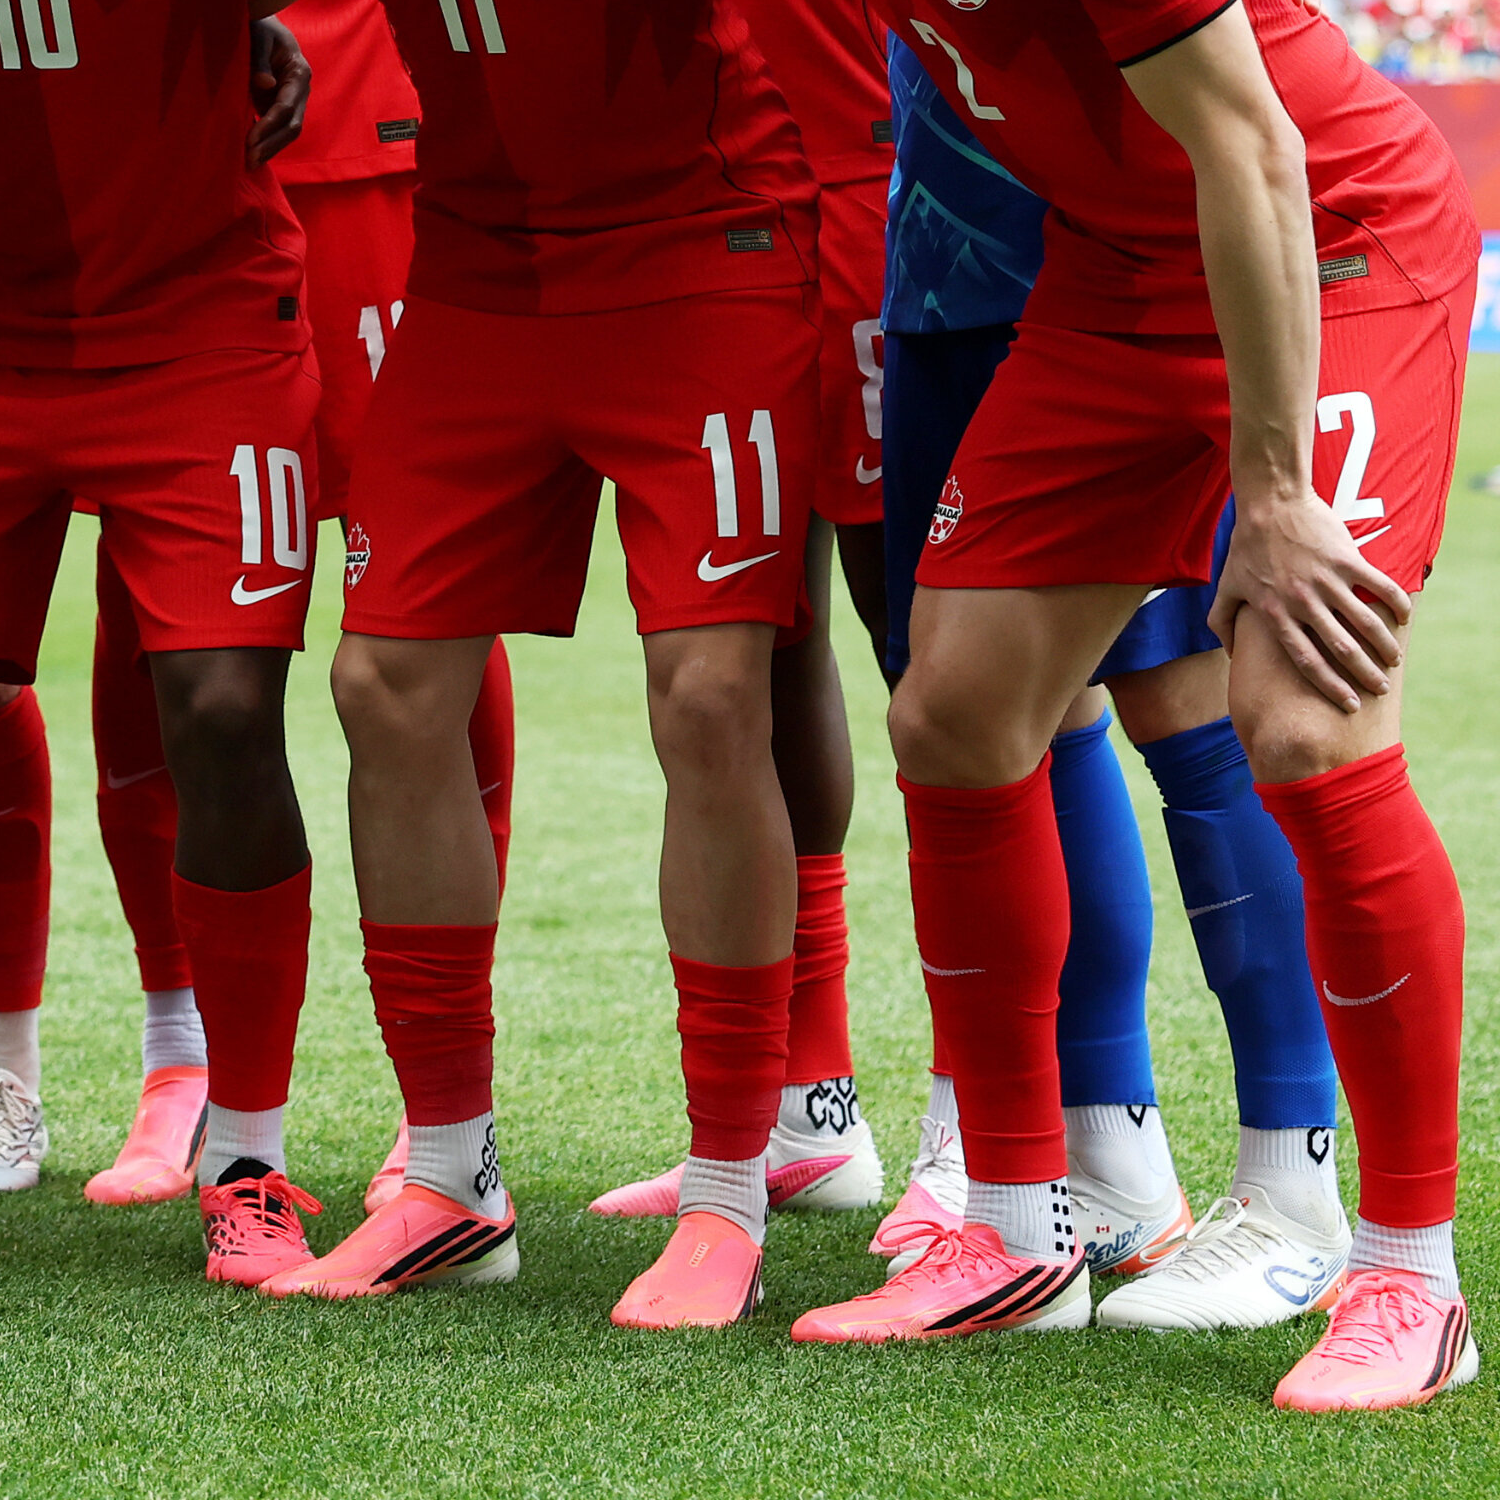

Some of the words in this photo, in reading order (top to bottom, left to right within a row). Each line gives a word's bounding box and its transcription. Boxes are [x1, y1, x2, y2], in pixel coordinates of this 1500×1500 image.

[909, 18, 1006, 120] 2
[229, 444, 307, 571] 10
[701, 410, 780, 538] 11
[1316, 391, 1385, 522] 2
